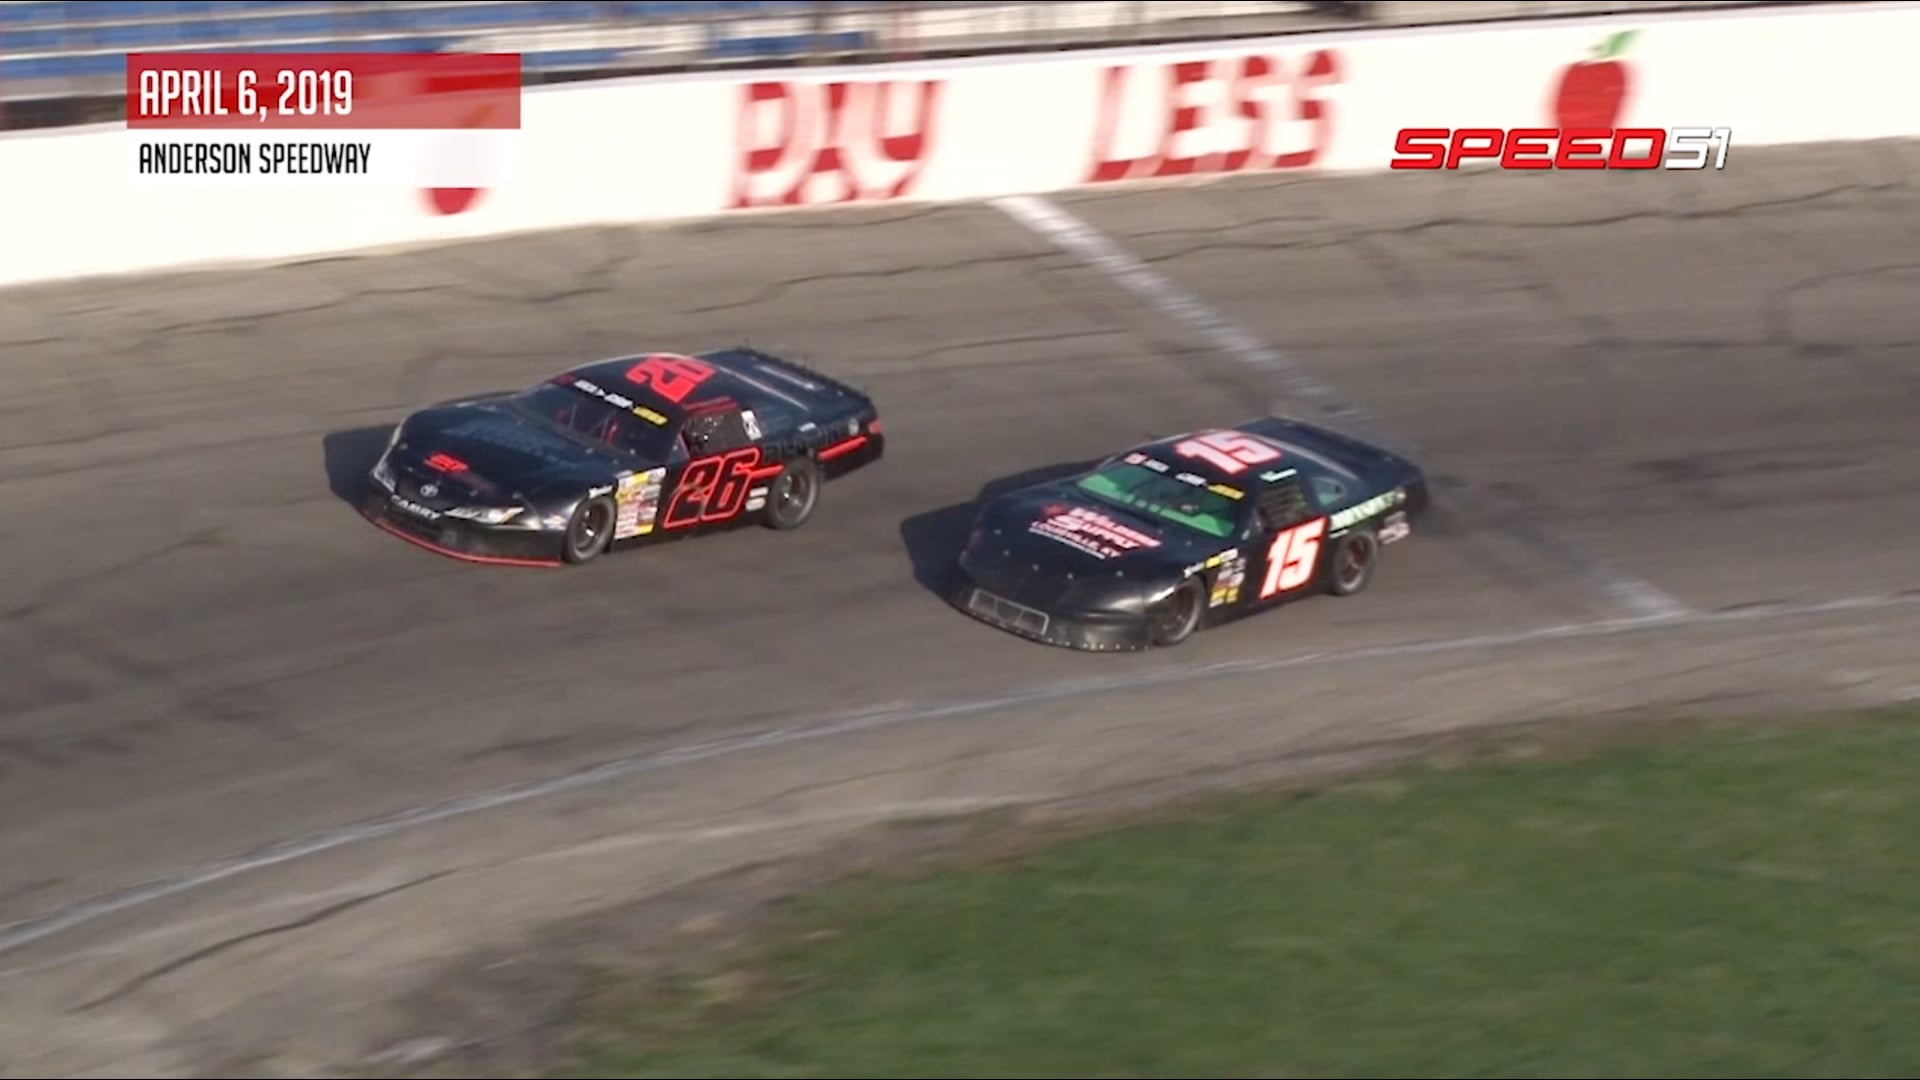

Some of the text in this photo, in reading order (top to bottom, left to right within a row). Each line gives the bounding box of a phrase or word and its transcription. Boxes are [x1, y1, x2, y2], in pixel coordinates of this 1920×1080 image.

[730, 48, 1343, 207] PAY LESS
[624, 356, 717, 403] 26
[663, 446, 761, 529] 26
[1174, 429, 1284, 476] 15
[1257, 514, 1330, 601] 15
